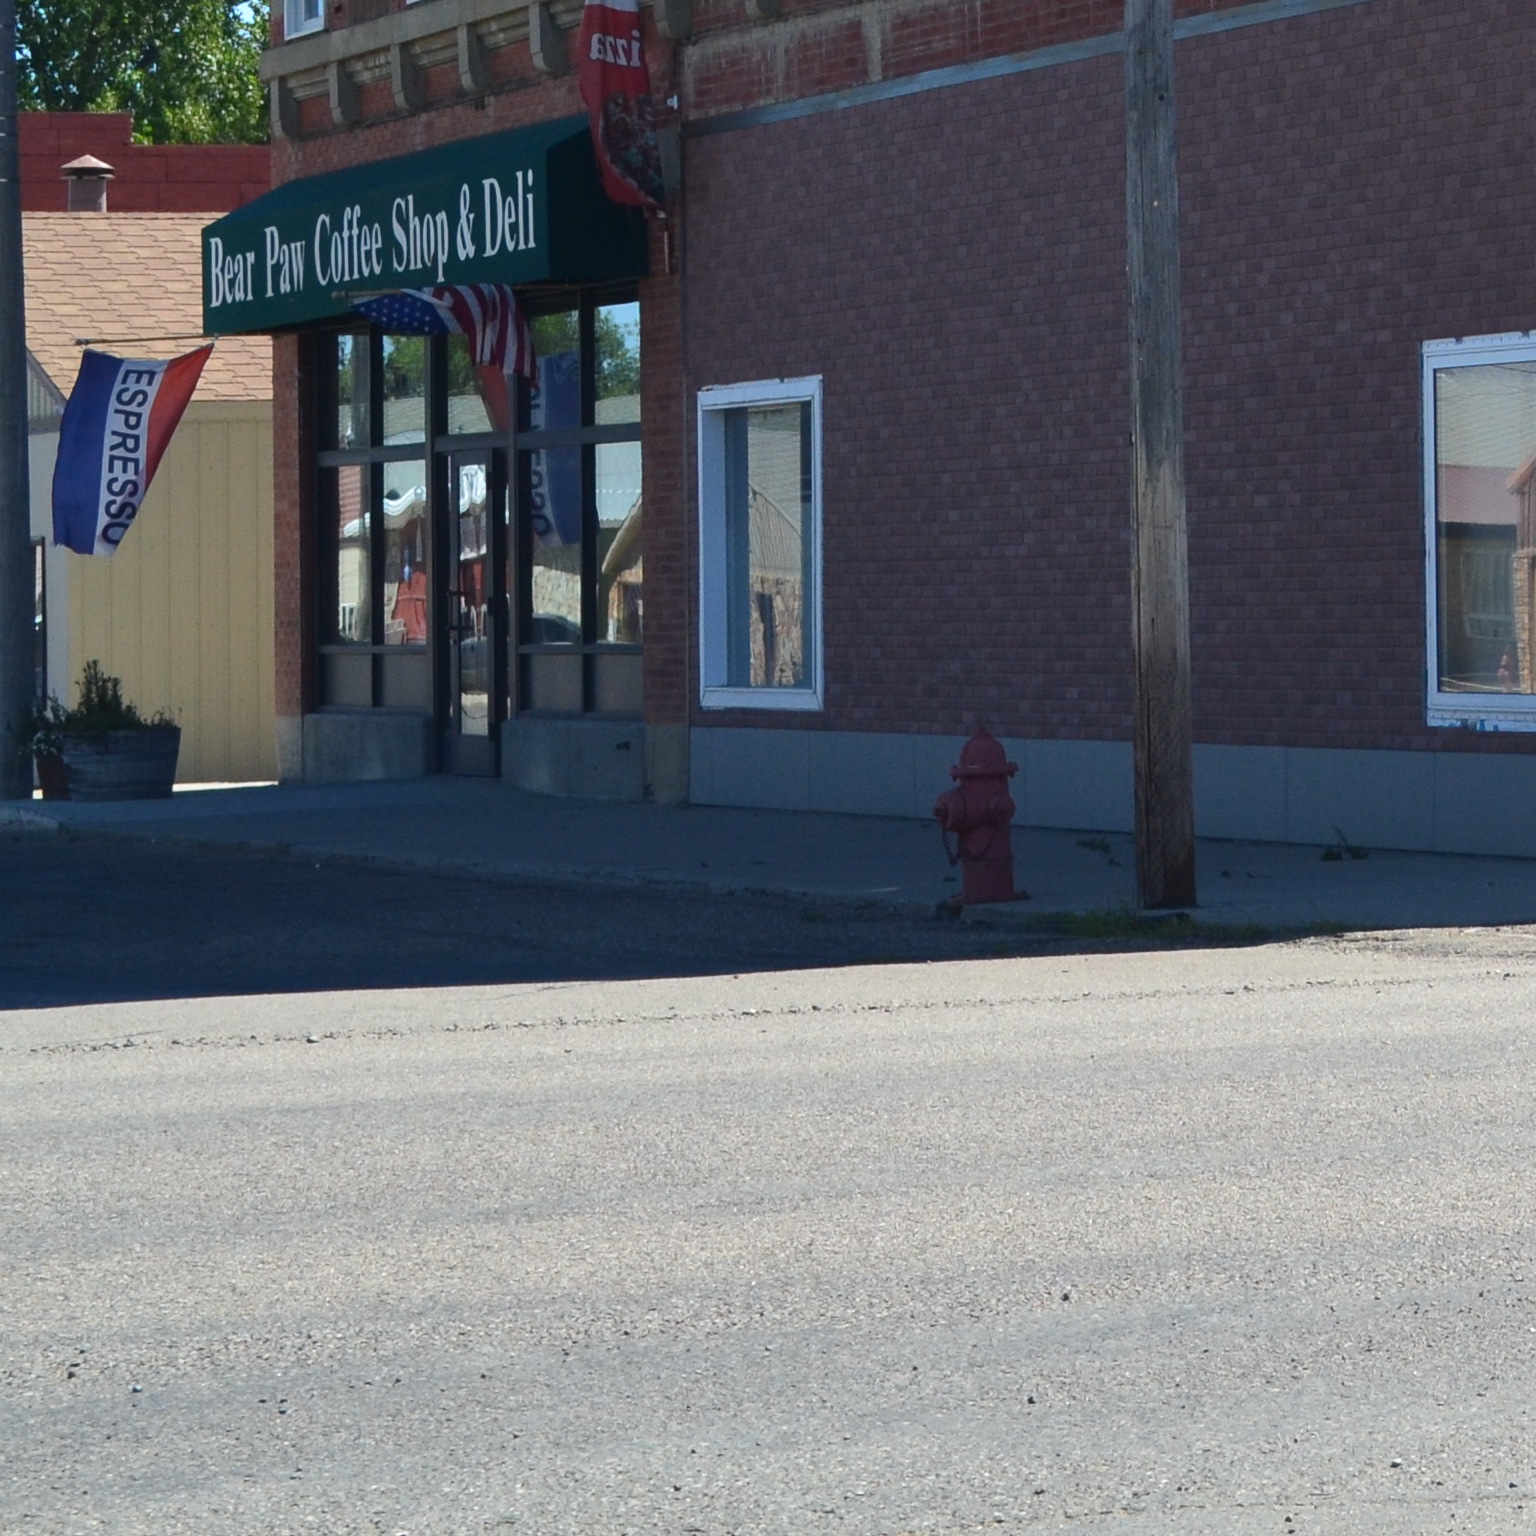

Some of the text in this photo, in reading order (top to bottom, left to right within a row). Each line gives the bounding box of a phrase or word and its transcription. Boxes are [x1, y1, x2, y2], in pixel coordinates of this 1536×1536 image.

[208, 168, 537, 308] Bear Paw Coffee Shop & Deli
[101, 368, 157, 546] ESPRESSO
